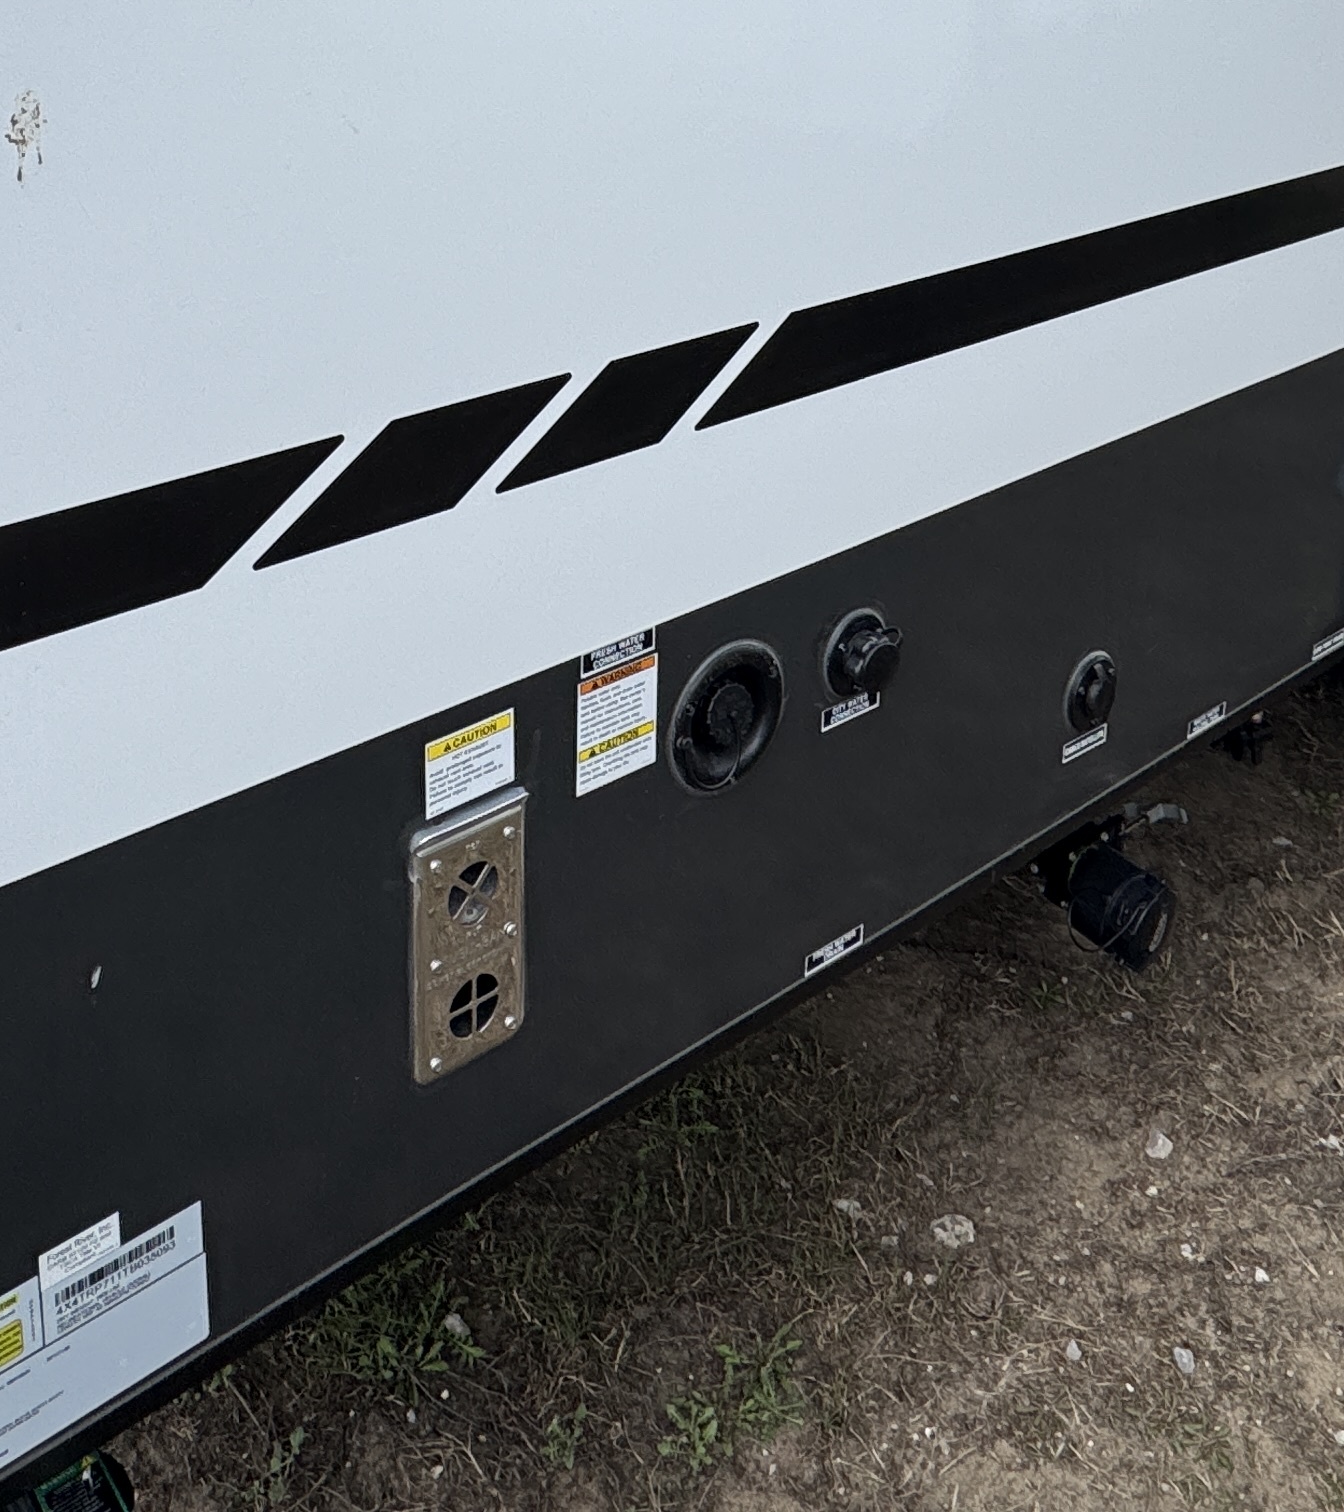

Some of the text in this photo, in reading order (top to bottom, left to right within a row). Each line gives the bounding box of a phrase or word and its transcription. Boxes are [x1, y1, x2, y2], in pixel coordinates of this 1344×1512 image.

[590, 632, 645, 661] FRESH WATER
[593, 643, 644, 670] CONNECTION
[453, 722, 497, 749] CAUTION
[600, 728, 639, 753] CAUTION
